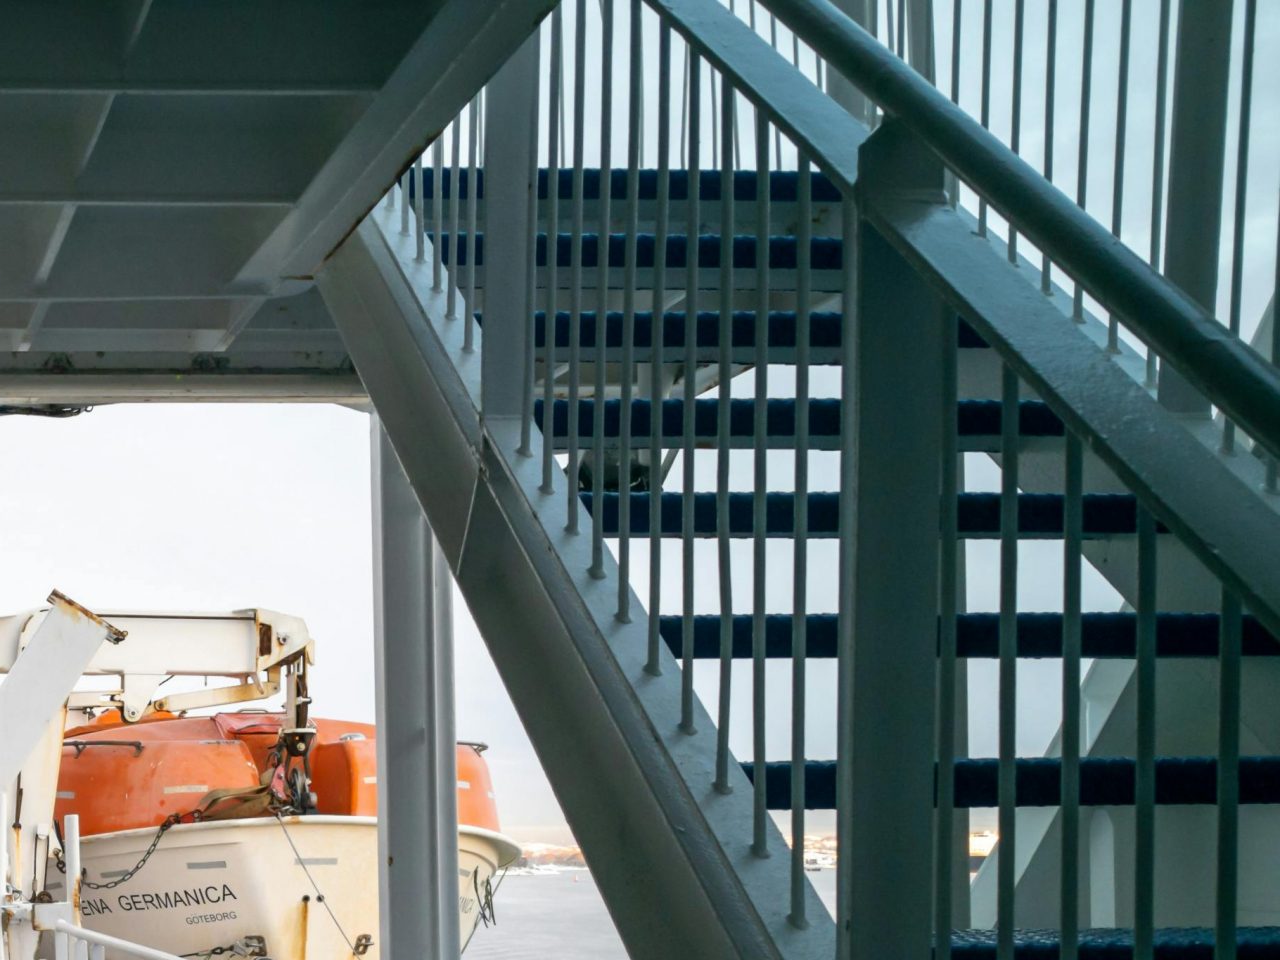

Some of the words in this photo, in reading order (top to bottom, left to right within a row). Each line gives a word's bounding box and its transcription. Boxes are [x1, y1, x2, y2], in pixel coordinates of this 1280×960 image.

[81, 899, 113, 916] ENA
[118, 884, 237, 911] GERMANICA
[186, 911, 237, 925] GÖTEBORG
